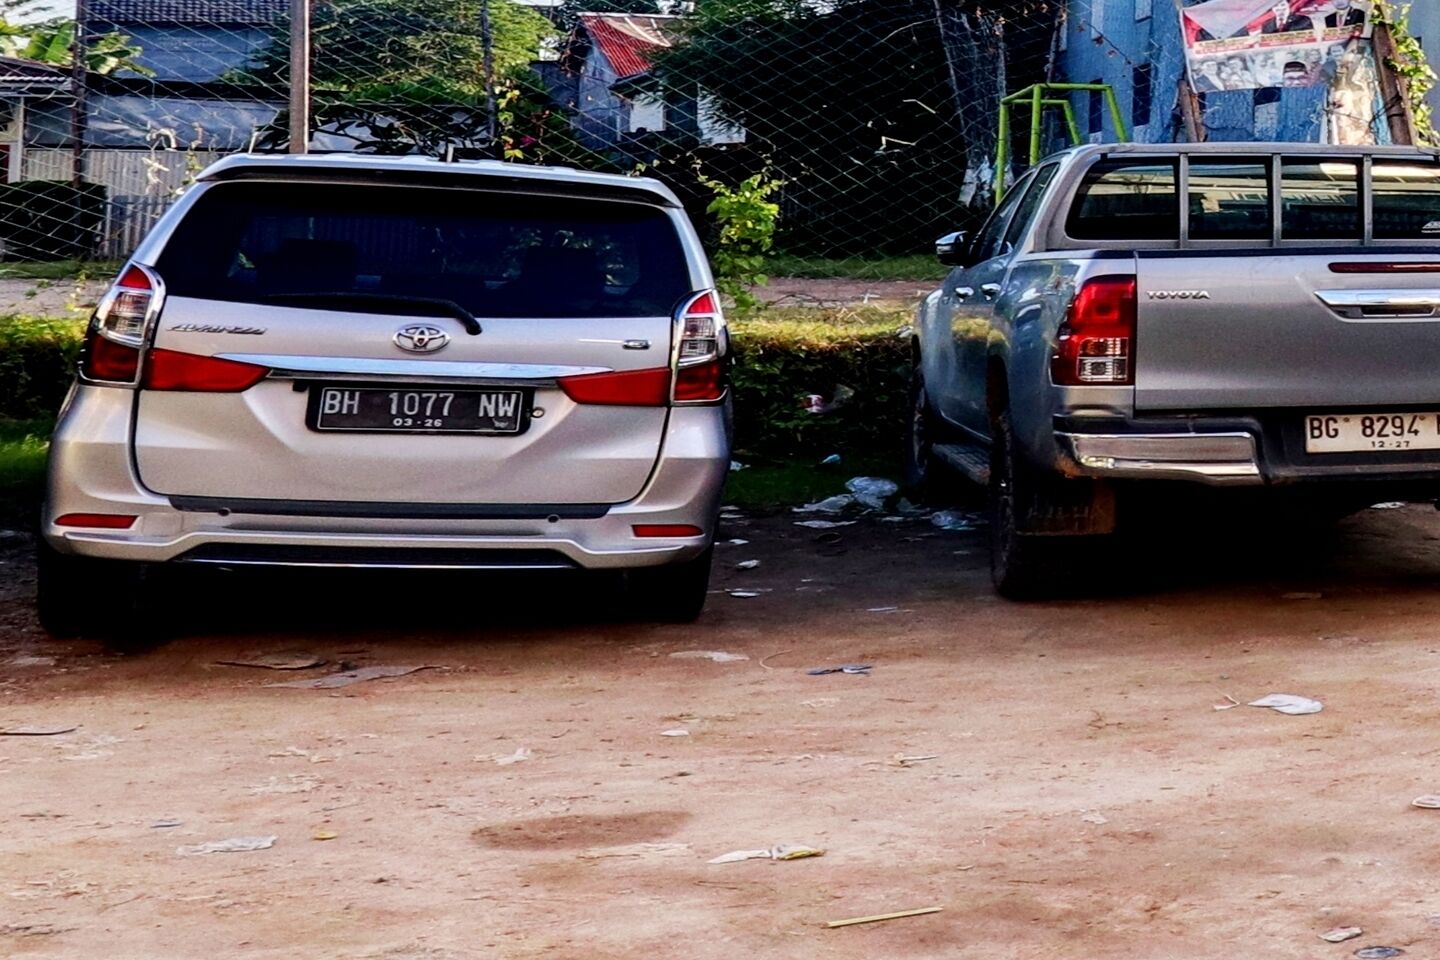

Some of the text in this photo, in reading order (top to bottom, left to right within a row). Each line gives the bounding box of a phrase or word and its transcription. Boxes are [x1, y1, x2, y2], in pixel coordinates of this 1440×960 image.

[1146, 289, 1210, 300] TOYOTA
[323, 391, 517, 418] BH 1077 NW
[1309, 416, 1338, 439] BG
[1361, 415, 1420, 438] 8294
